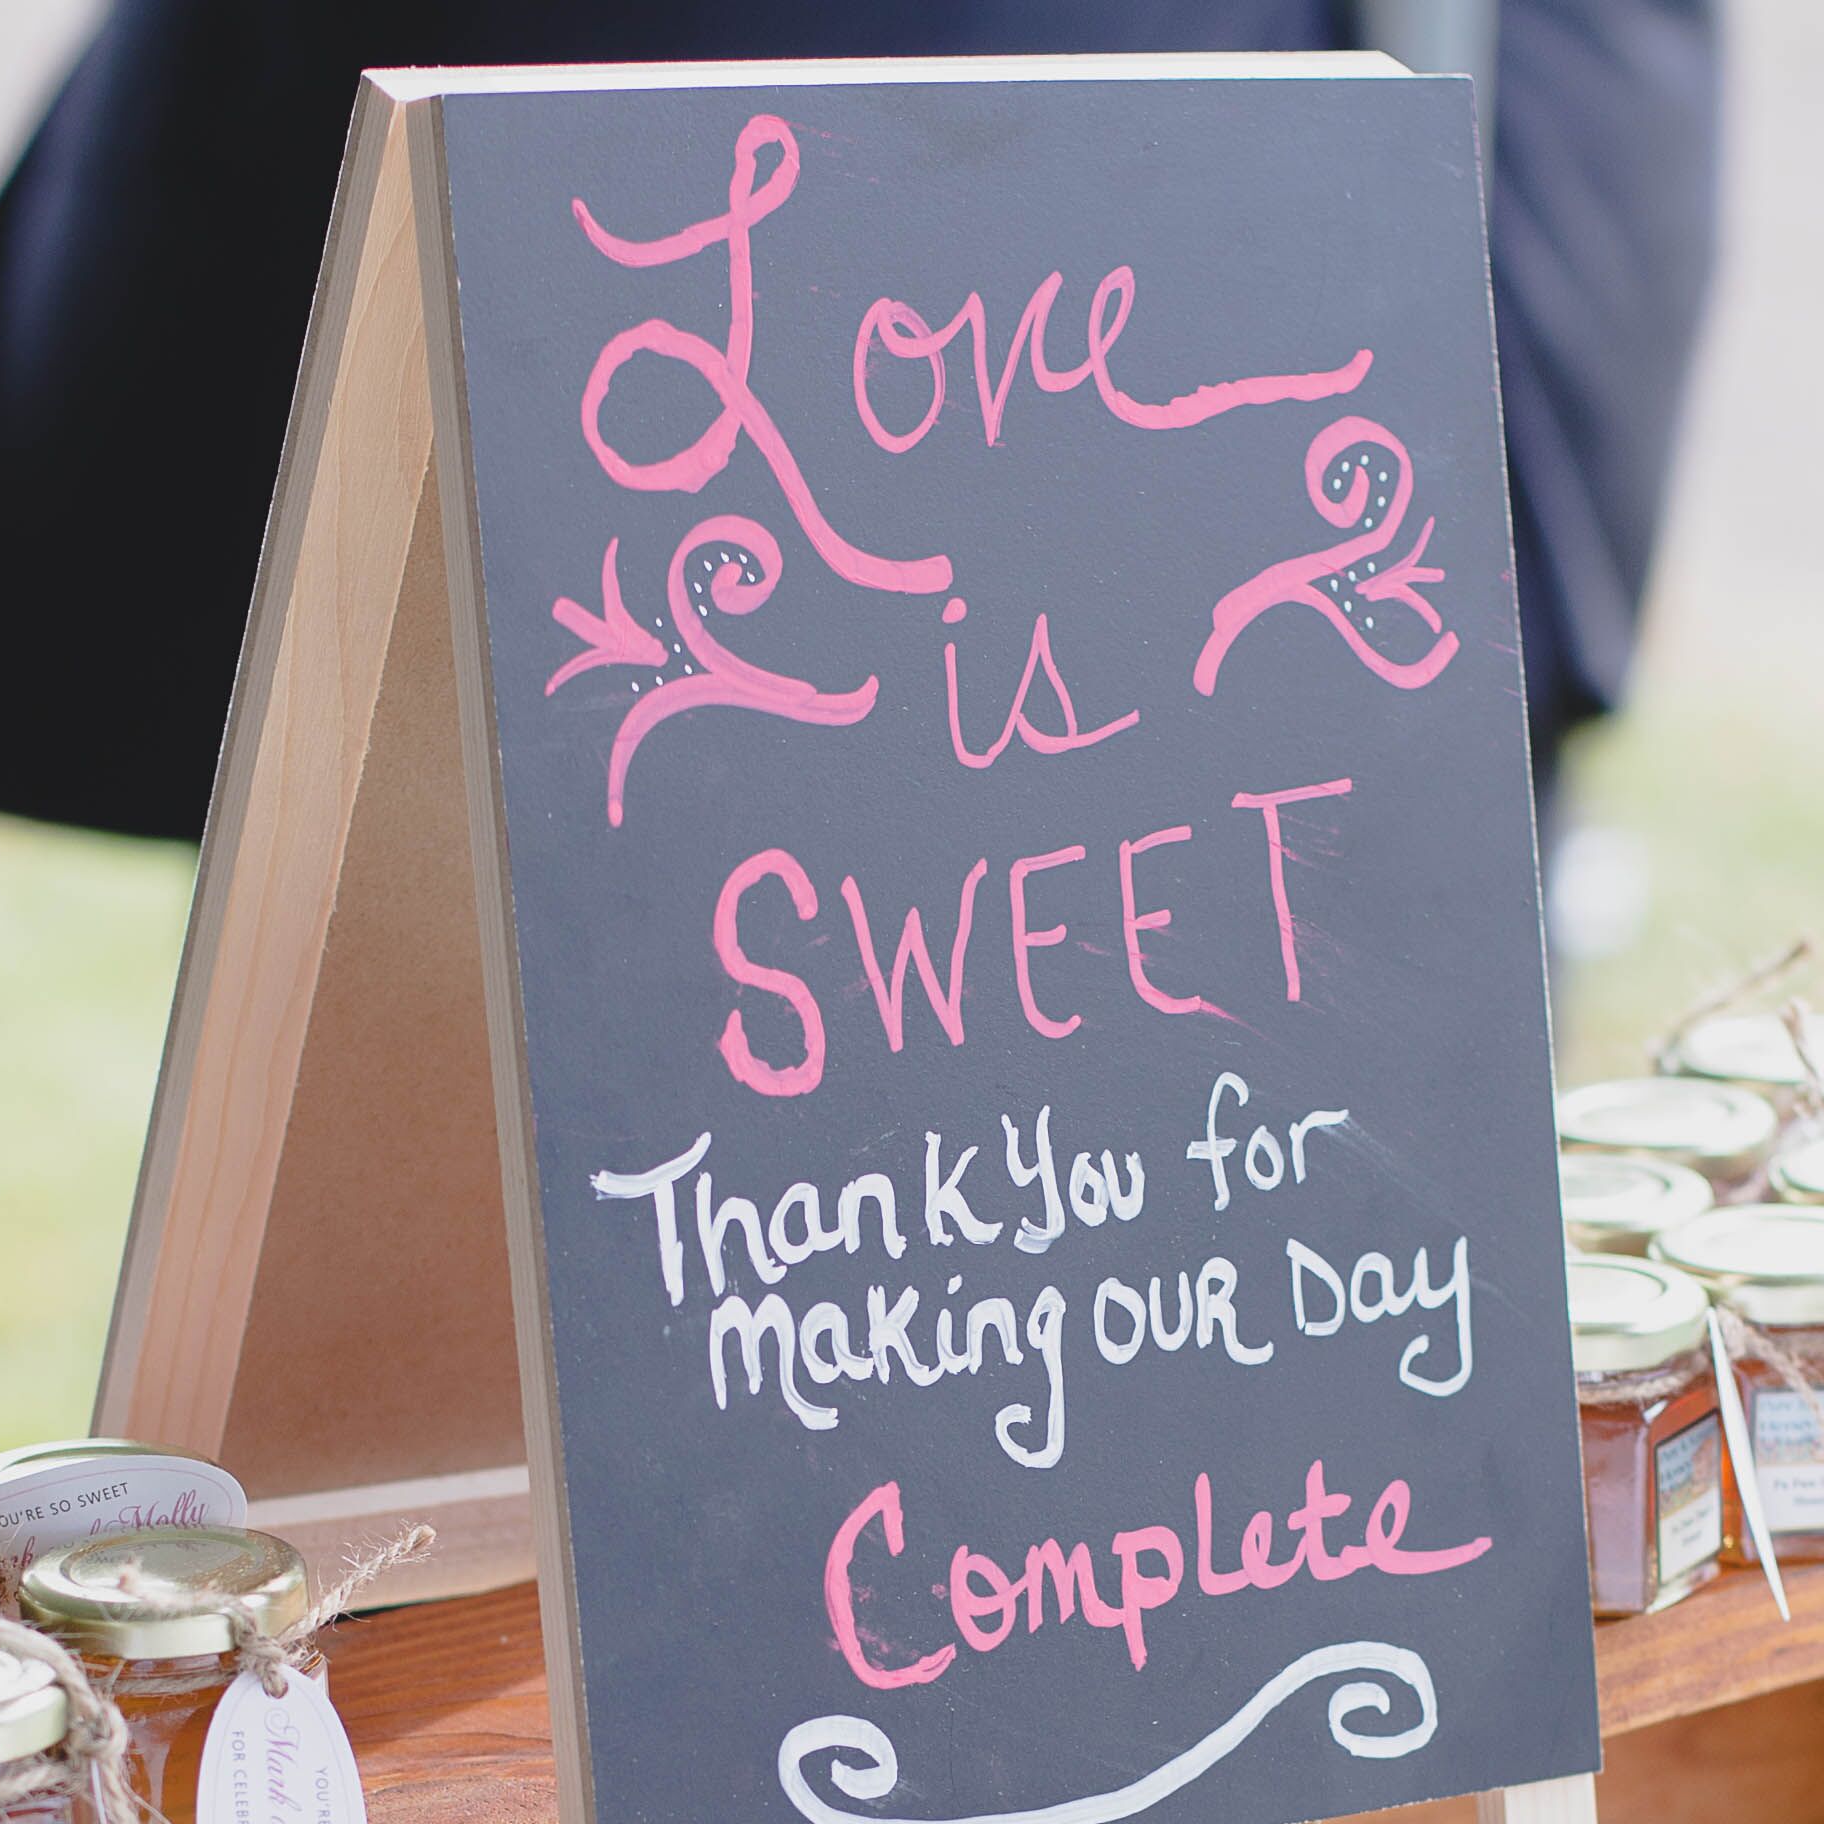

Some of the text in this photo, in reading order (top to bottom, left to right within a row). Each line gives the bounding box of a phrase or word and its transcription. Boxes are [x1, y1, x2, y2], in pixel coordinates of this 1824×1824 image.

[572, 113, 1374, 594] Love
[938, 598, 1141, 769] is
[713, 778, 1353, 1096] SWEET
[999, 1103, 1145, 1254] You
[1186, 1071, 1350, 1211] for
[1286, 1236, 1472, 1396] Day
[50, 1500, 71, 1517] SO
[78, 1482, 129, 1508] SWEET
[823, 1459, 1494, 1691] Complete
[232, 1730, 246, 1762] FOR
[264, 1707, 303, 1812] Mark
